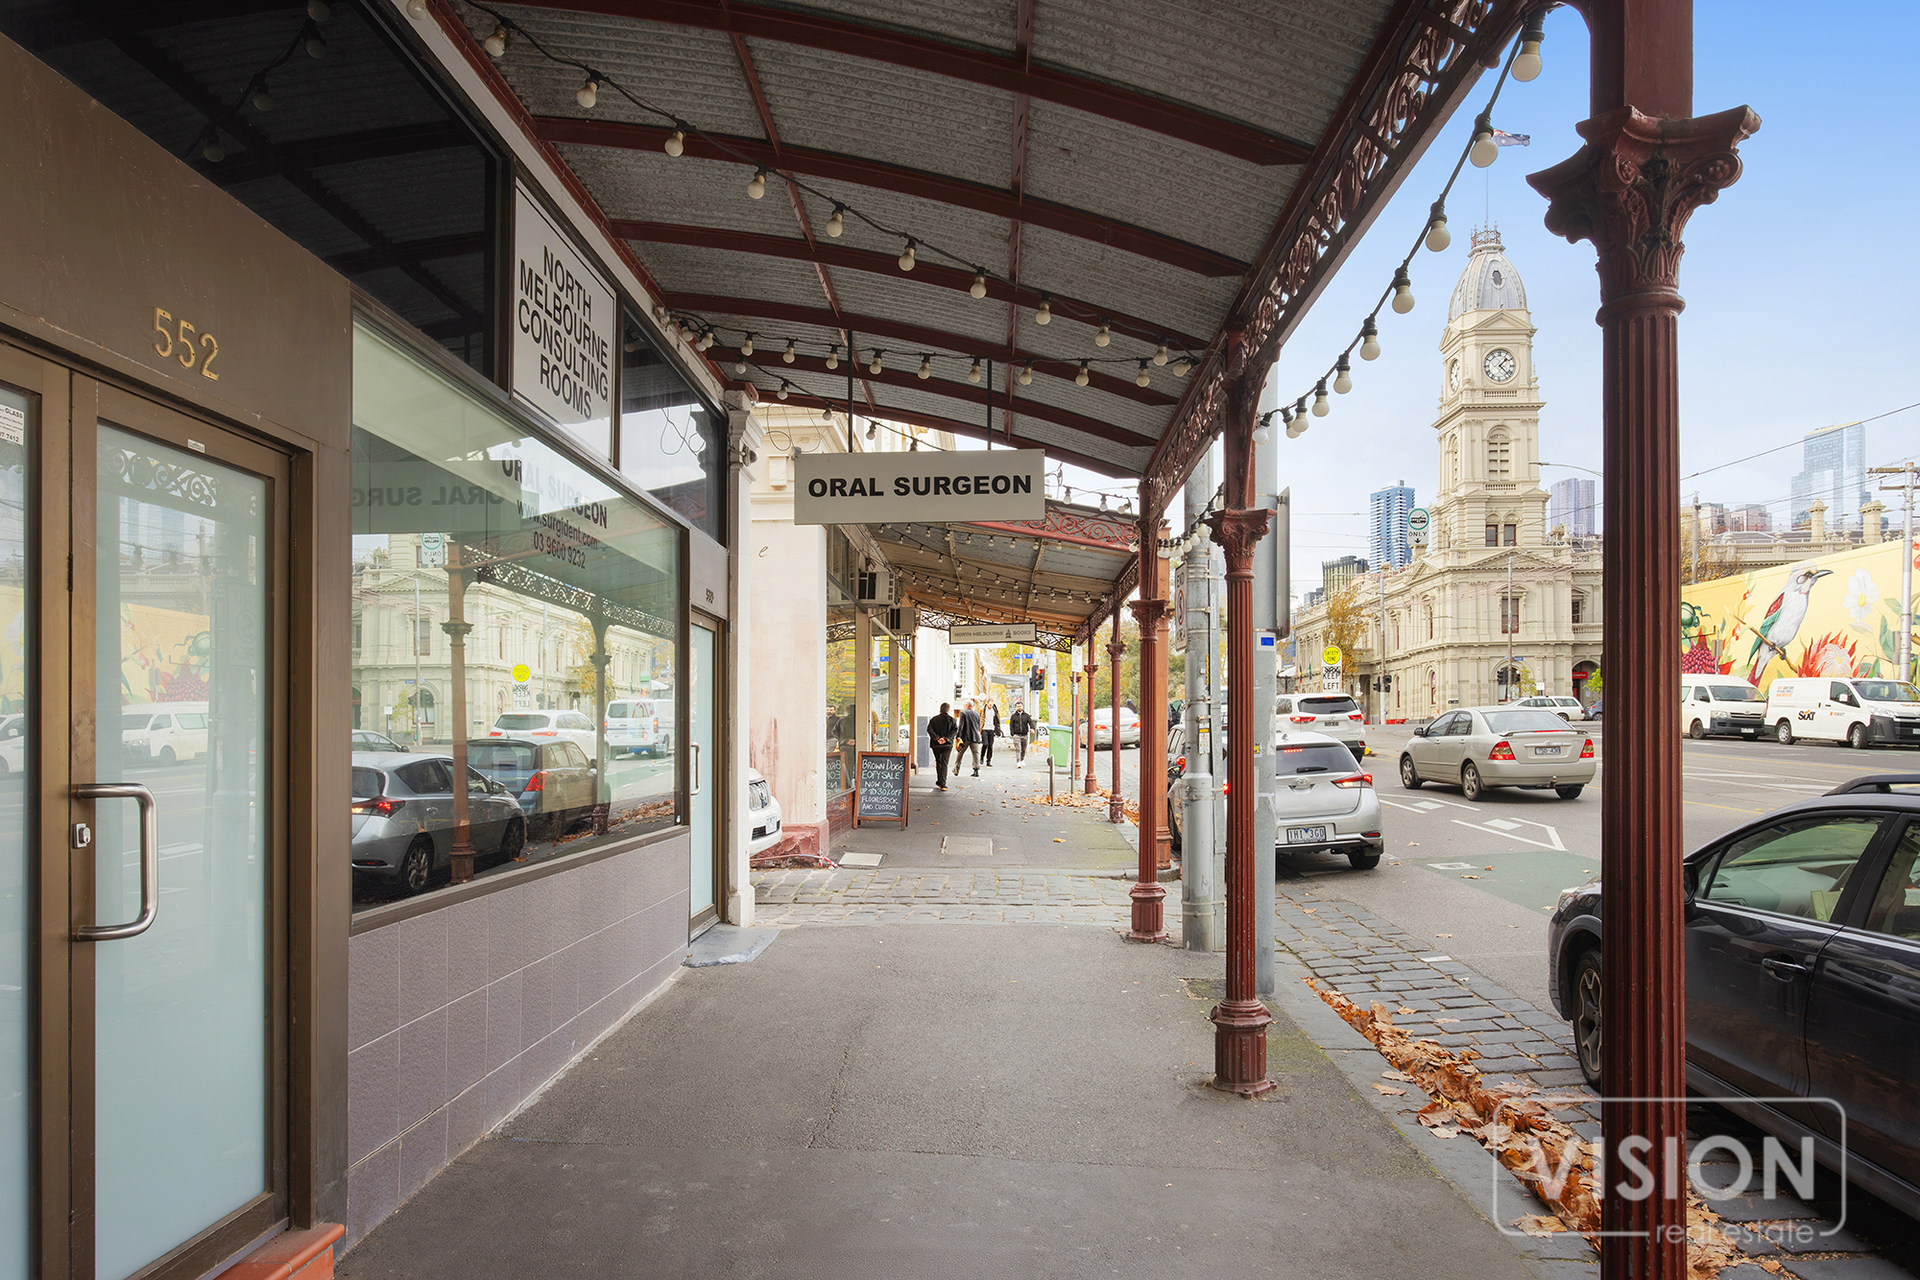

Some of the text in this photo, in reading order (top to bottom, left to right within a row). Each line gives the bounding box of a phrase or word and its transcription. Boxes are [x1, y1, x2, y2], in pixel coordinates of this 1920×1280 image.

[544, 245, 592, 322] NORTH
[520, 258, 608, 370] MELBOURNE
[153, 307, 219, 381] 552
[518, 298, 608, 402] CONSULTING
[540, 353, 592, 421] ROOMS
[5, 407, 23, 419] GLASS
[502, 448, 607, 529] ORAL SURGEON
[808, 475, 1031, 498] ORAL SURGEON
[533, 531, 586, 569] 03 9600 9232
[1323, 671, 1340, 680] KEEP
[1323, 682, 1339, 690] LEFT
[881, 771, 900, 780] SALE
[882, 781, 893, 789] ON
